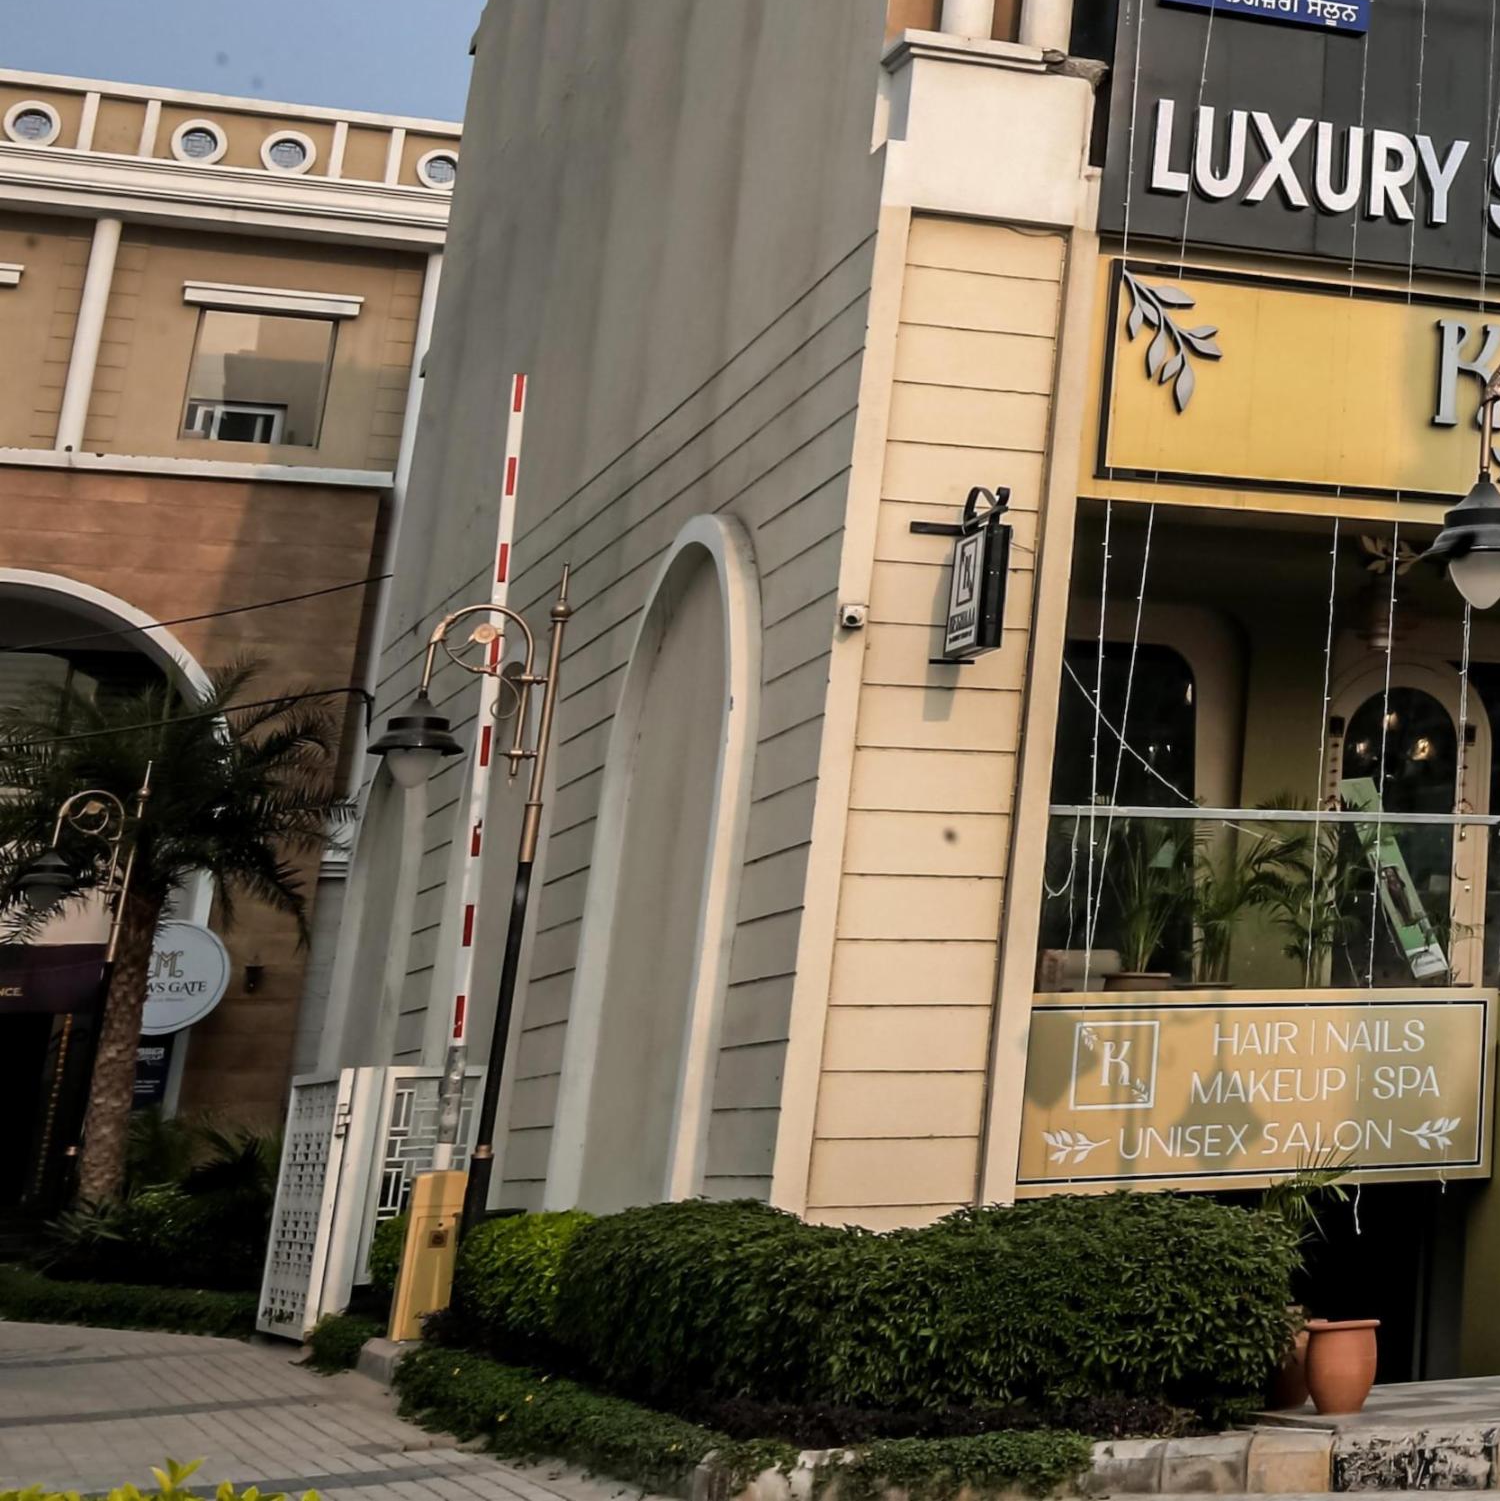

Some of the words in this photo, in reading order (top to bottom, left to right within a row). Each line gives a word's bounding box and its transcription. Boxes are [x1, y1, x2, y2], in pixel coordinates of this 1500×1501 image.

[1149, 97, 1470, 225] LUXURY
[168, 980, 208, 997] GATE
[1212, 1021, 1298, 1056] HAIR
[1325, 1019, 1426, 1053] NAILS
[1190, 1066, 1347, 1105] MAKEUP
[1372, 1064, 1442, 1100] SPA
[1117, 1123, 1249, 1160] UNISEX
[1262, 1118, 1393, 1155] SALON
